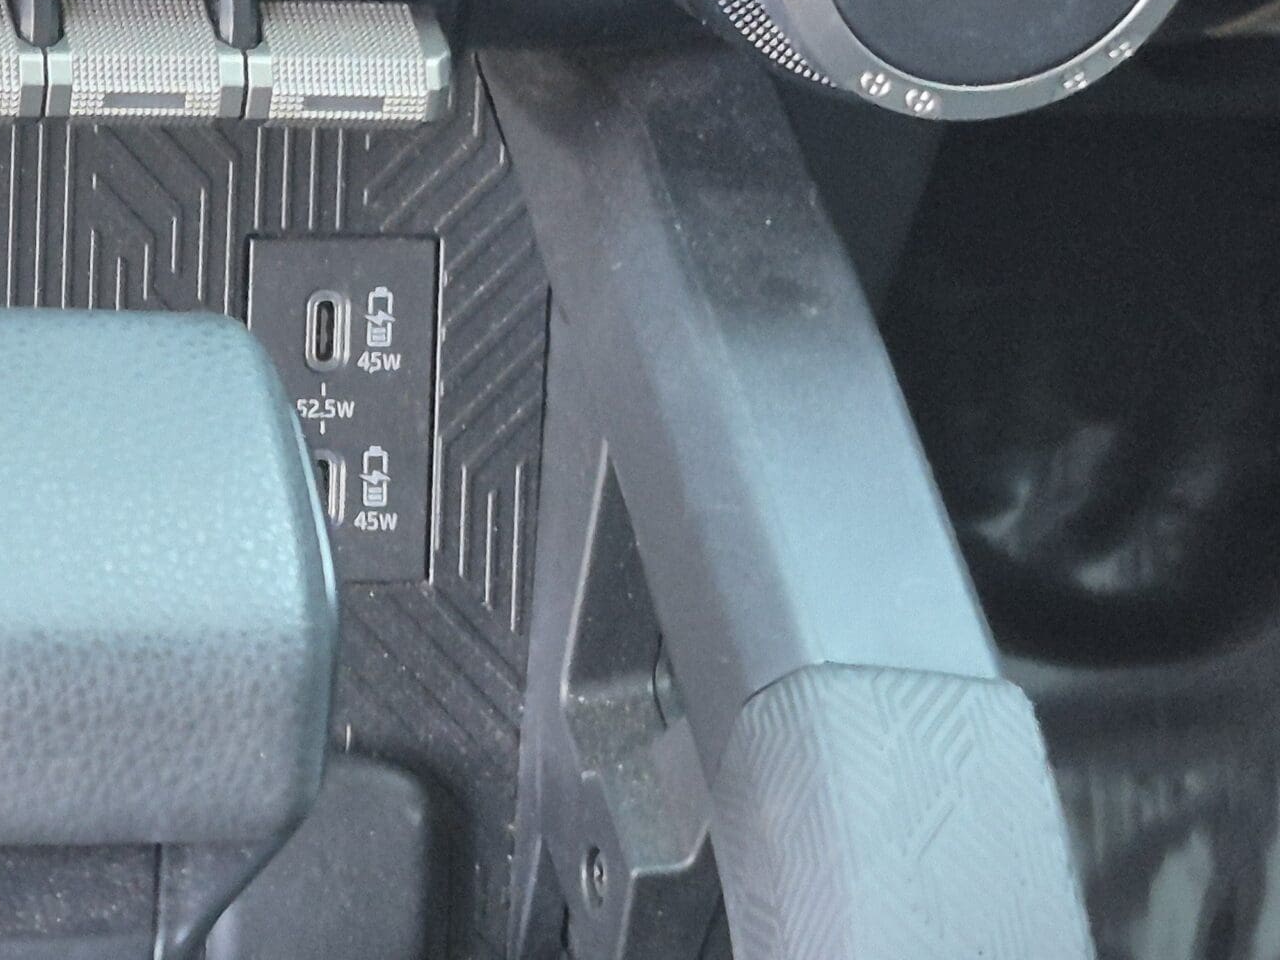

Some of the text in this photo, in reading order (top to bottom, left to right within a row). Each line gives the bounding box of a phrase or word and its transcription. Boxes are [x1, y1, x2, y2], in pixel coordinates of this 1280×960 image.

[356, 350, 402, 373] 45W
[296, 398, 356, 419] 52.5W
[353, 510, 399, 532] 45W
